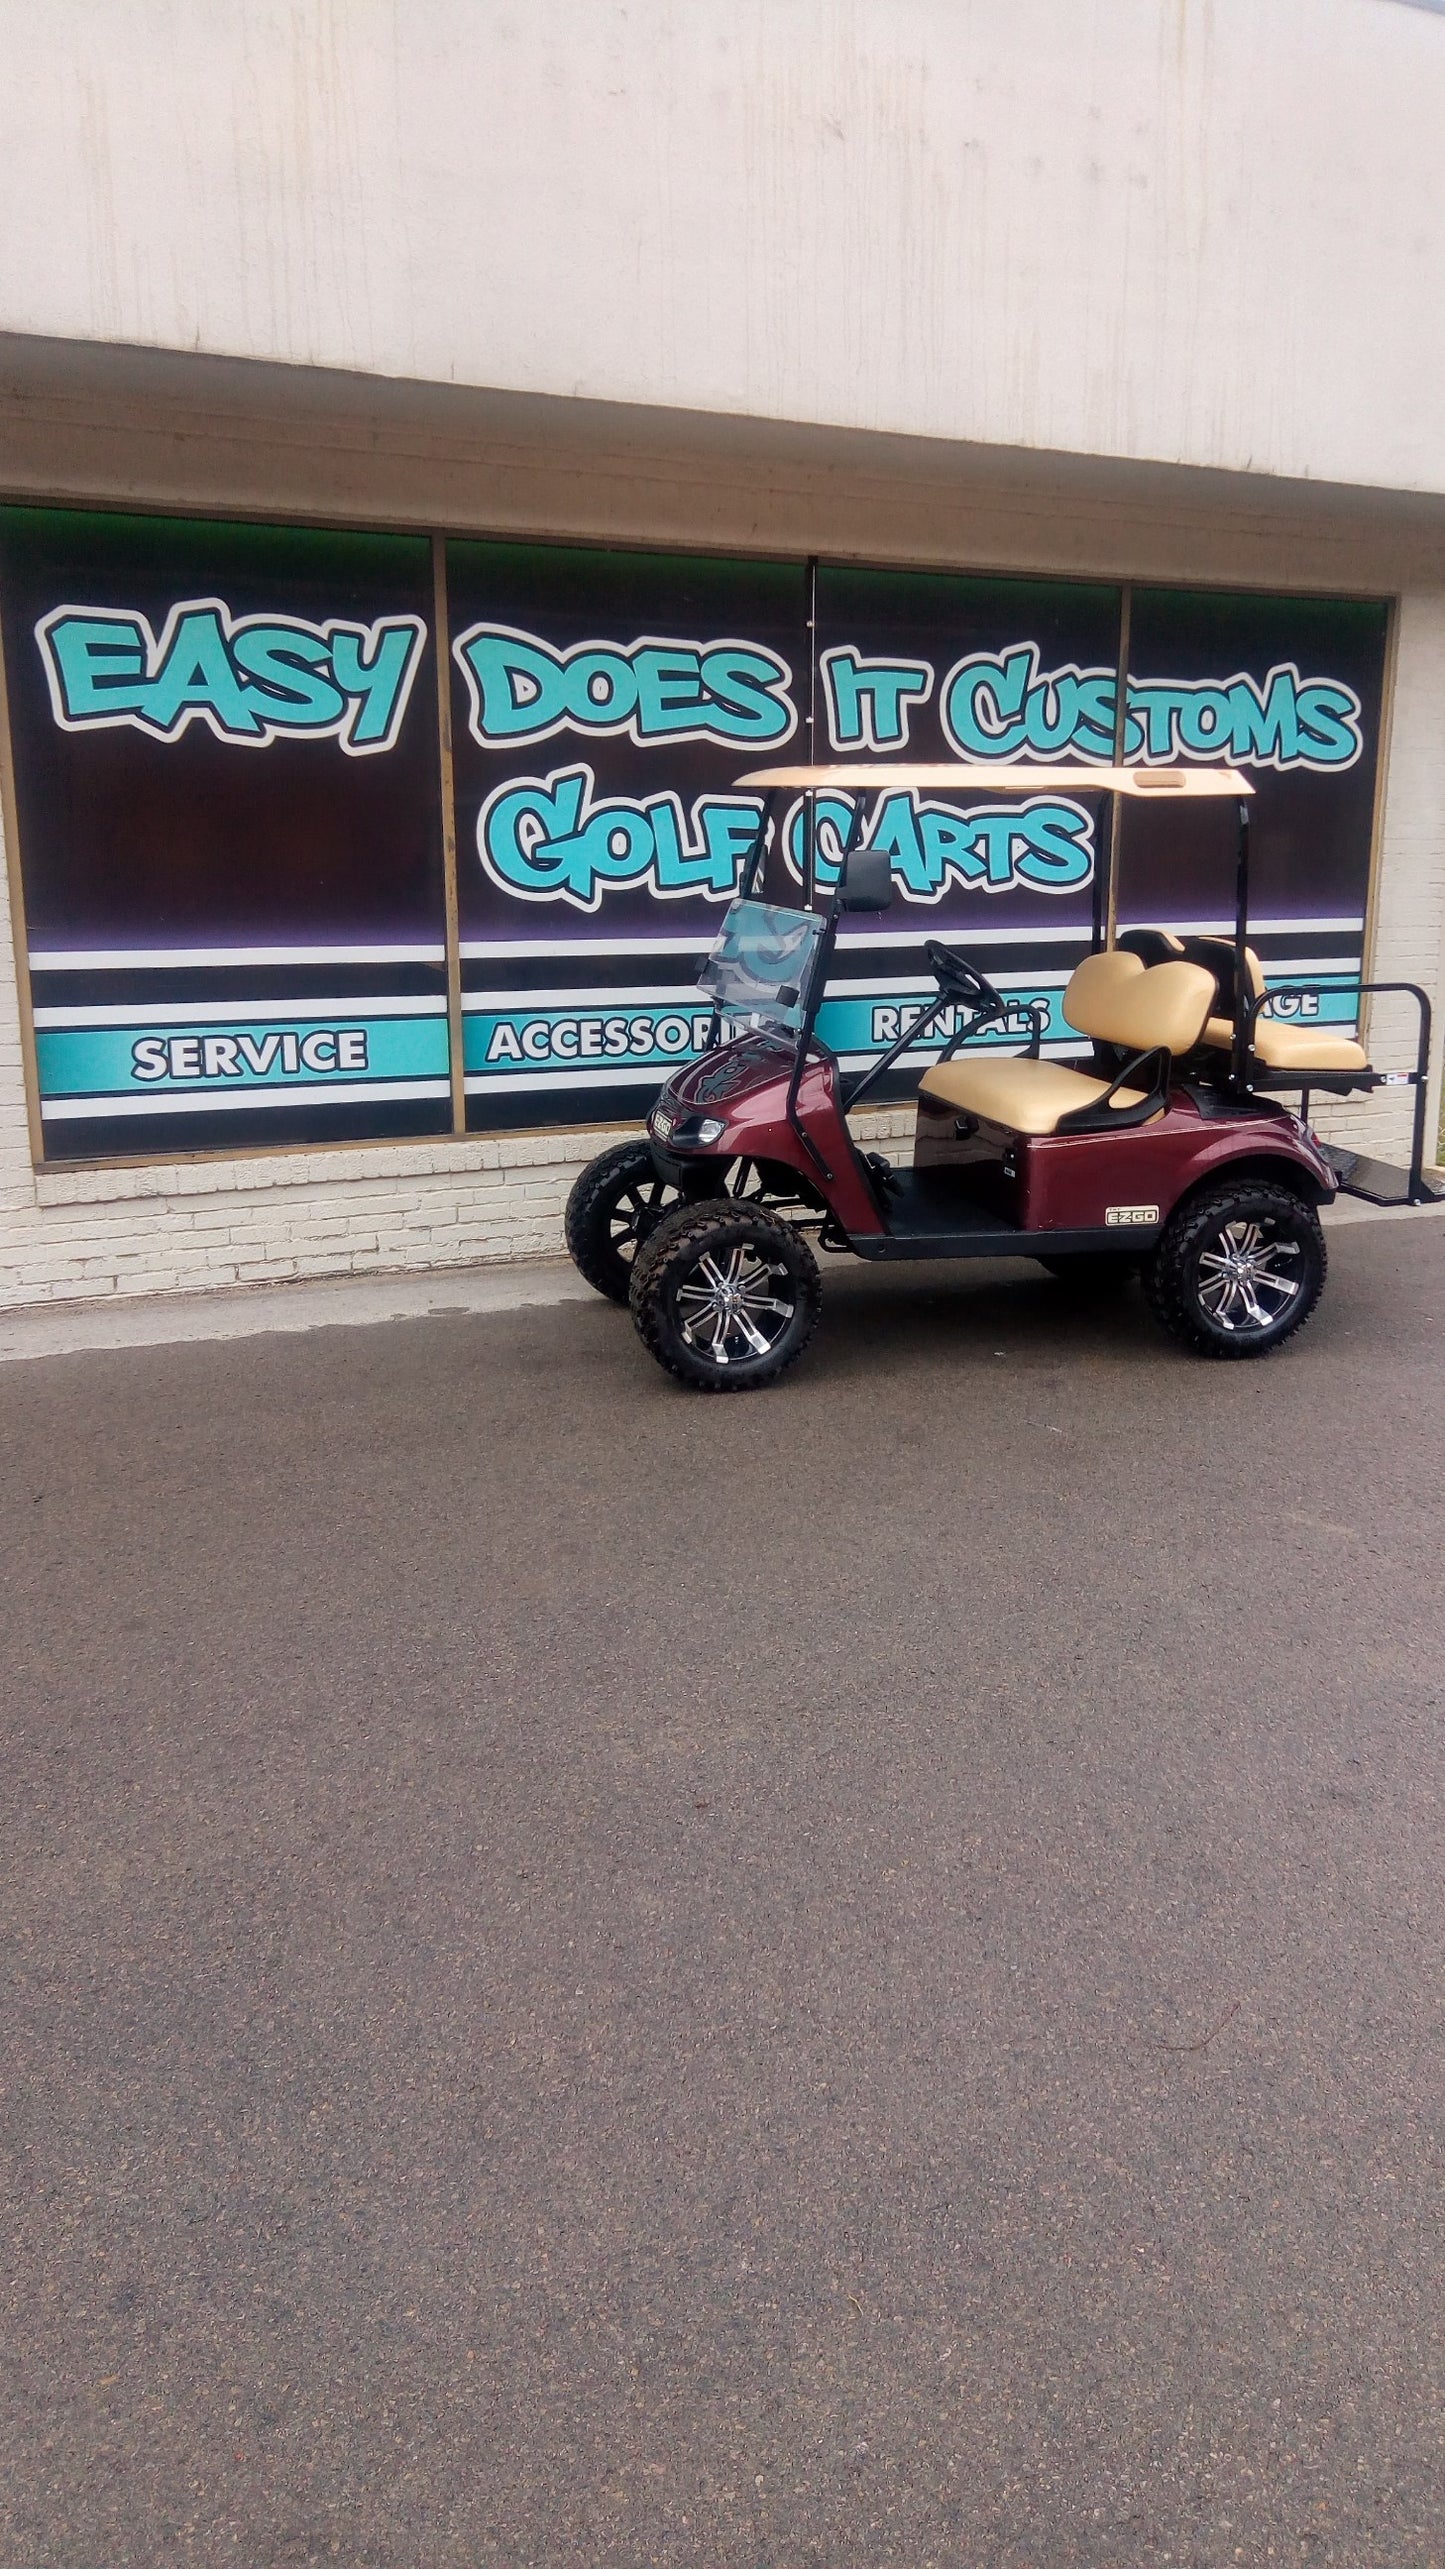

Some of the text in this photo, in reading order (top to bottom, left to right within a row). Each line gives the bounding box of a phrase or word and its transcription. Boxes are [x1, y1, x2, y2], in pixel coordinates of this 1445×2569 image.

[43, 604, 1358, 765] EASY DOES IT CUSTOMS
[484, 771, 1091, 903] GOLF CARTS
[132, 1030, 369, 1082] SERVICE
[486, 1014, 754, 1062] ACCESSORI
